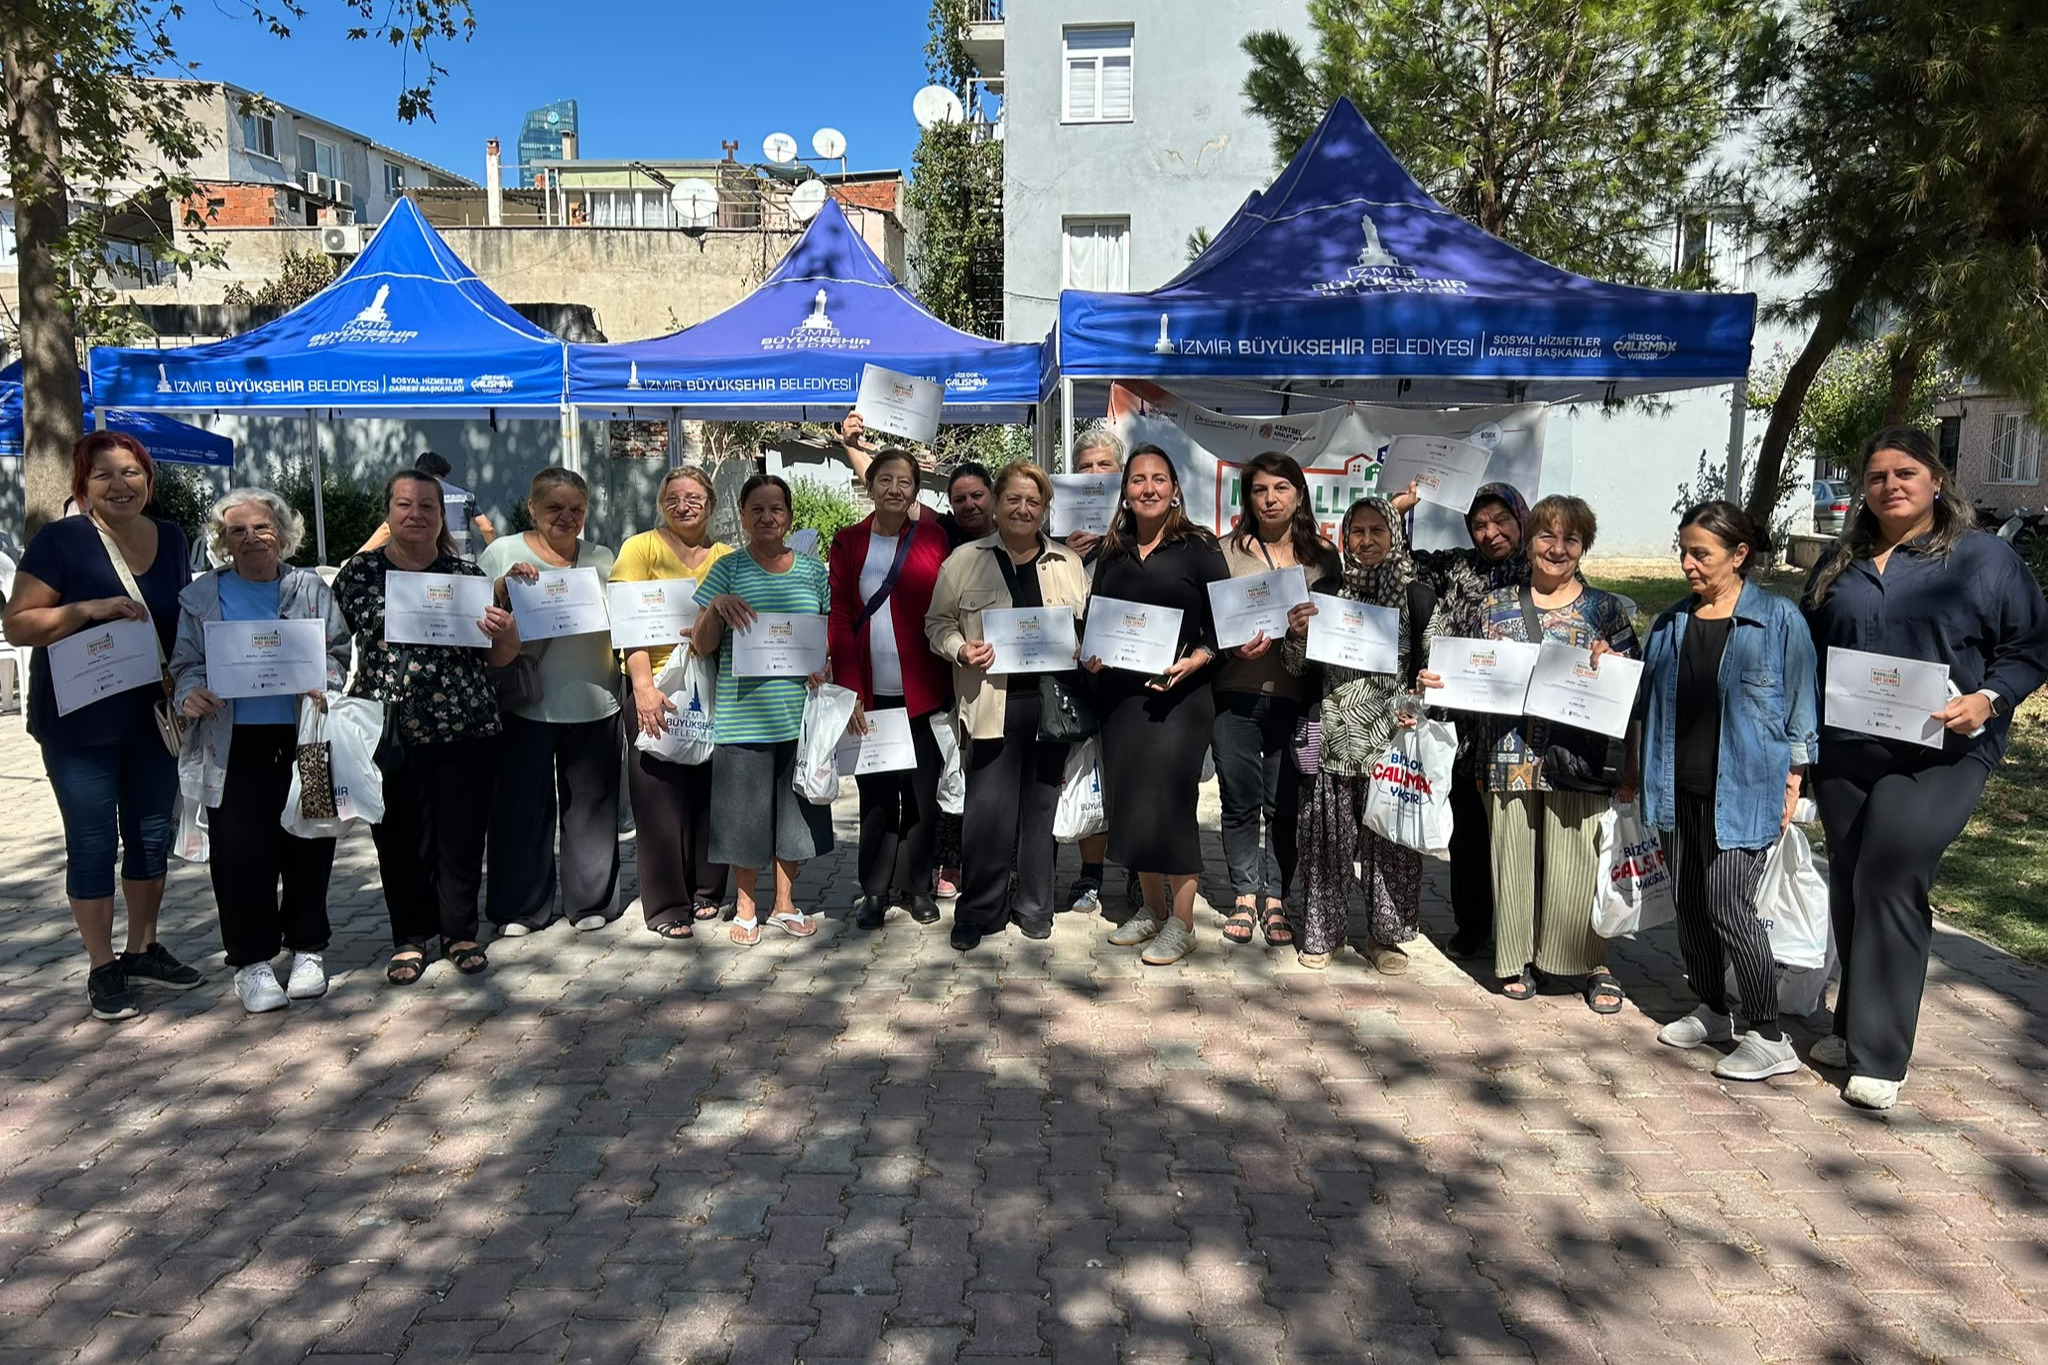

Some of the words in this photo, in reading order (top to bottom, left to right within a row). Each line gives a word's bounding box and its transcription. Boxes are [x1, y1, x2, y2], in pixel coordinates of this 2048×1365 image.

[1179, 338, 1232, 355] İZMİR
[1238, 336, 1365, 357] BÜYÜKŞEHİR
[1371, 338, 1475, 357] BELEDİYESİ
[1493, 335, 1536, 346] SOSYAL
[1539, 334, 1601, 347] HİZMETLER
[1489, 346, 1533, 357] DAİRESİ
[1535, 347, 1602, 359] BAŞKANLIĞI
[174, 380, 213, 393] İZMİR
[216, 378, 305, 394] BÜYÜKŞEHİR
[308, 378, 379, 393] BELEDİYESİ
[391, 377, 420, 385] SOSYAL
[422, 376, 464, 385] HİZMETLER
[644, 379, 682, 392] İZMİR
[686, 377, 776, 393] BÜYÜKŞEHİR
[780, 377, 851, 391] BELEDİYESİ
[389, 384, 418, 393] DAİRESİ
